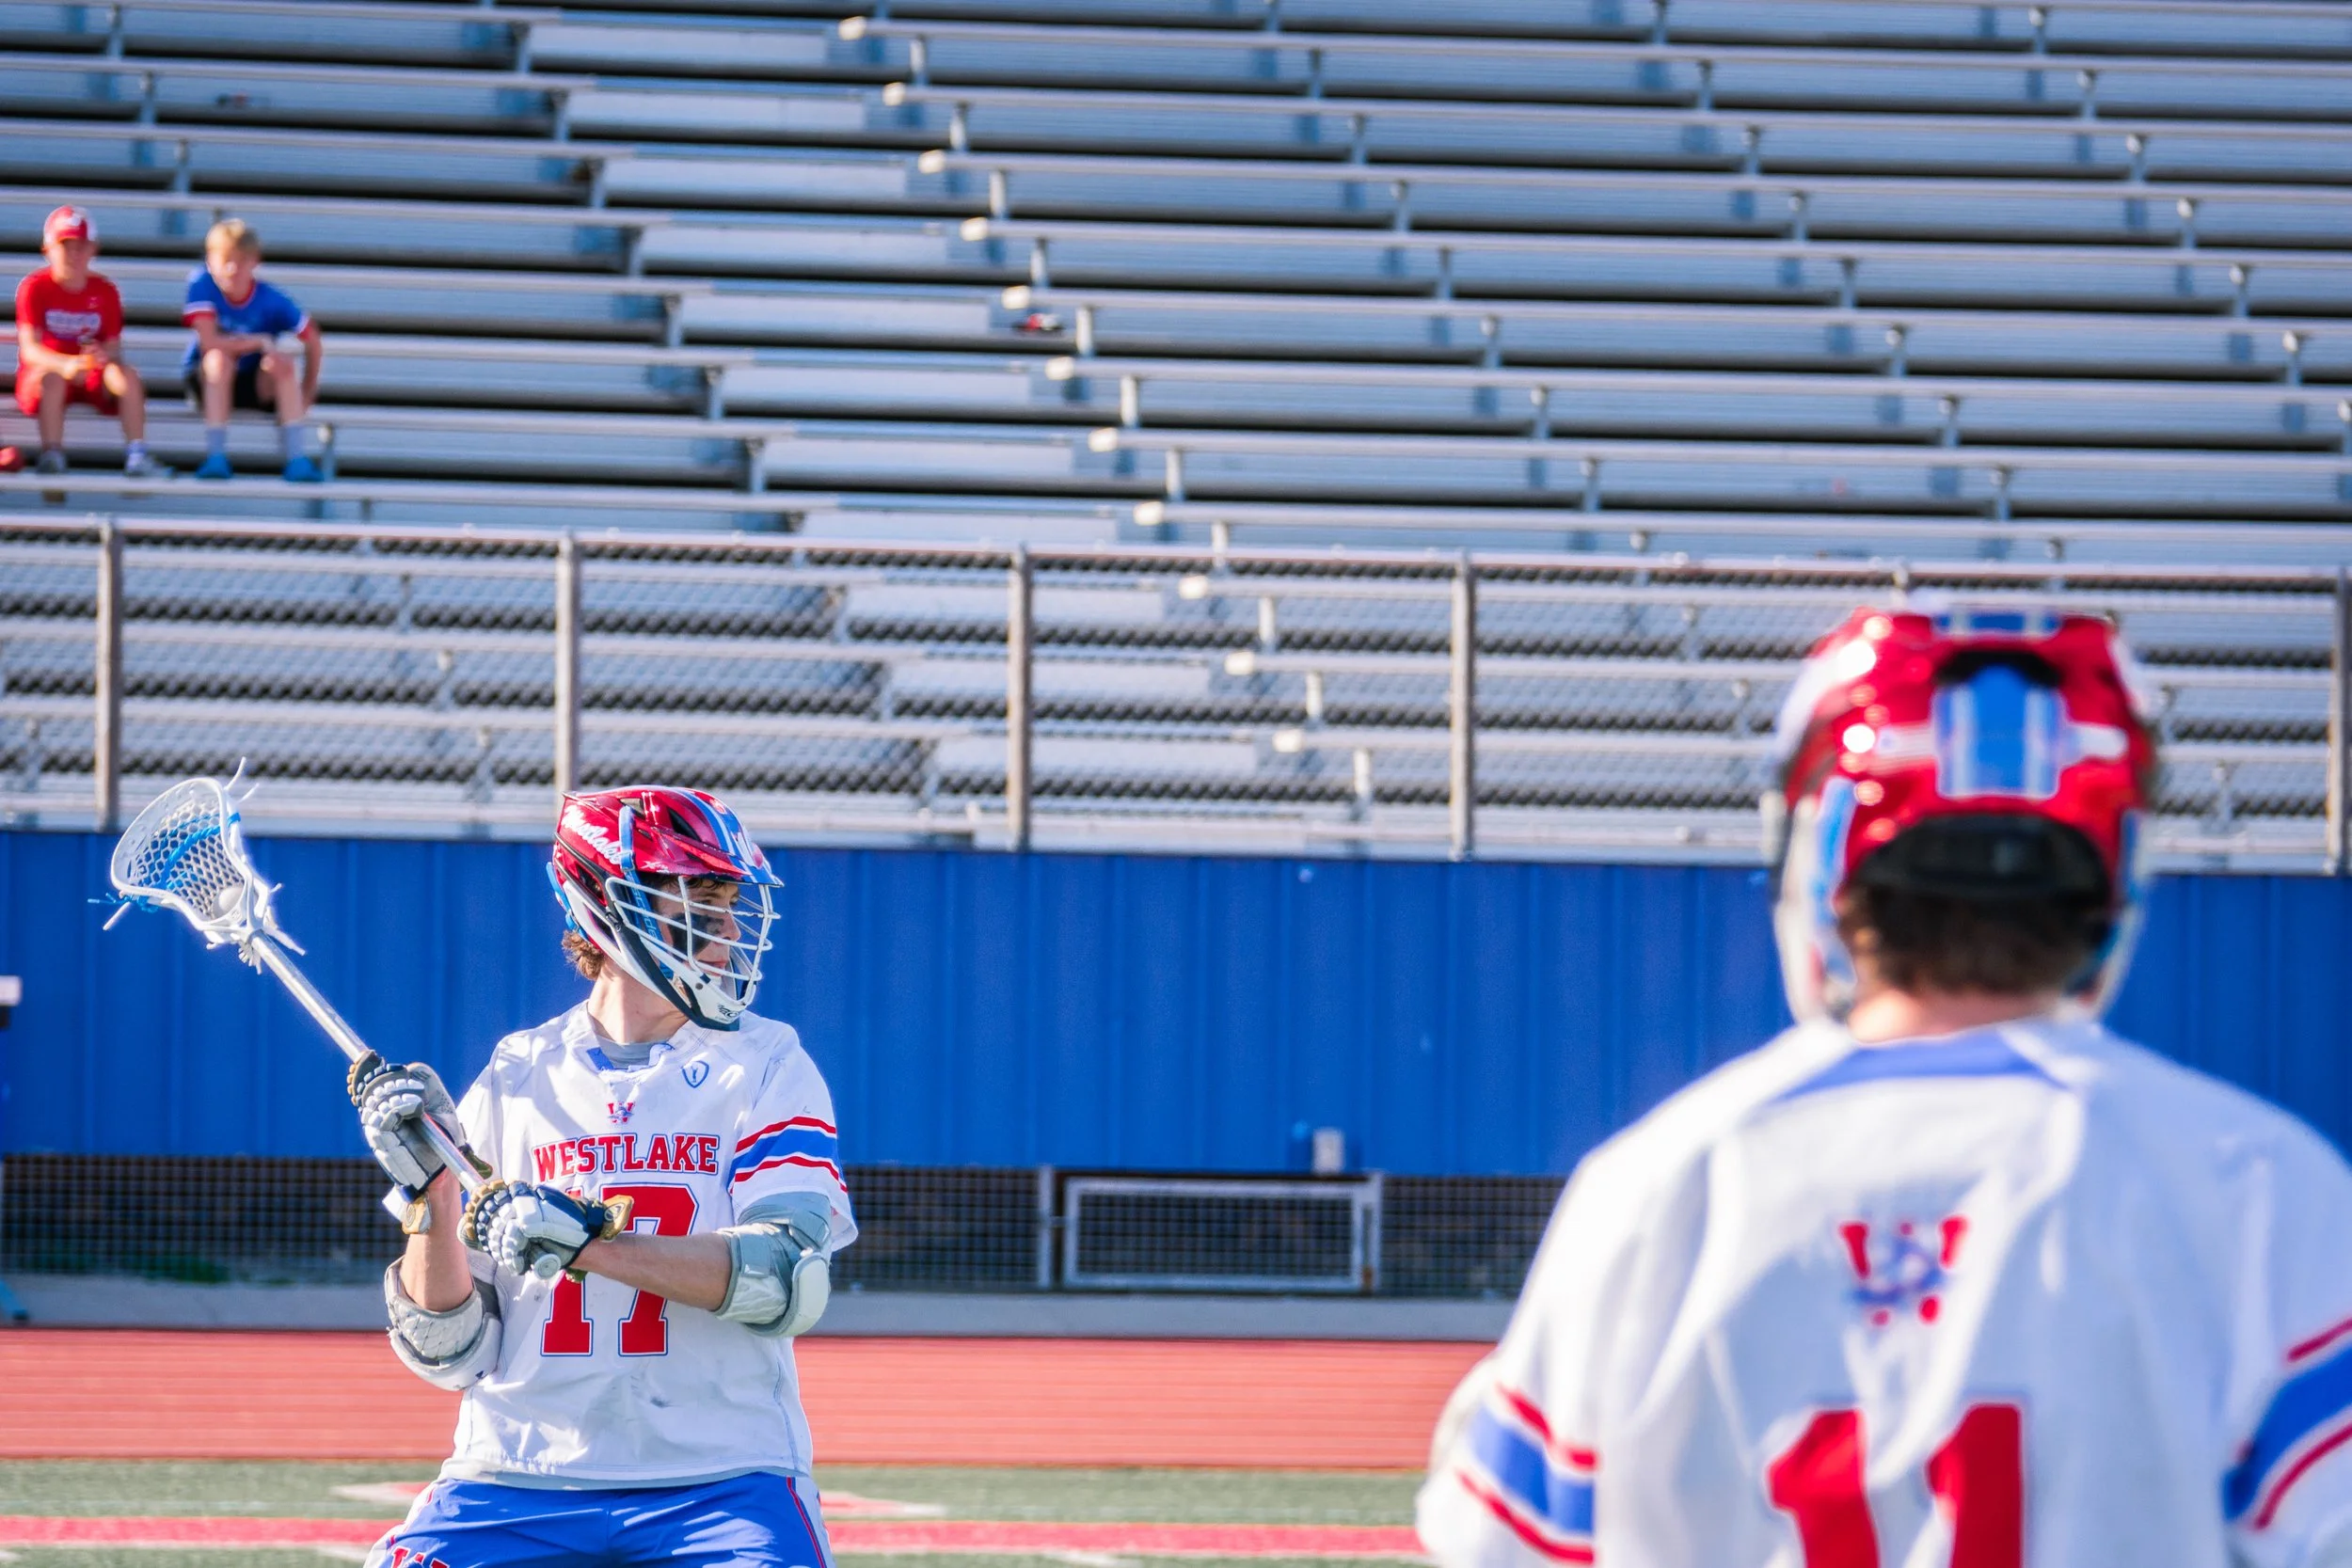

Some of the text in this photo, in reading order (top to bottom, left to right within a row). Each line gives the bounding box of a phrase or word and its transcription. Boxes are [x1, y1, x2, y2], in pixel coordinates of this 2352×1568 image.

[532, 1132, 720, 1182] WESTLAKE
[540, 1182, 699, 1357] 17
[1764, 1400, 2029, 1568] 11
